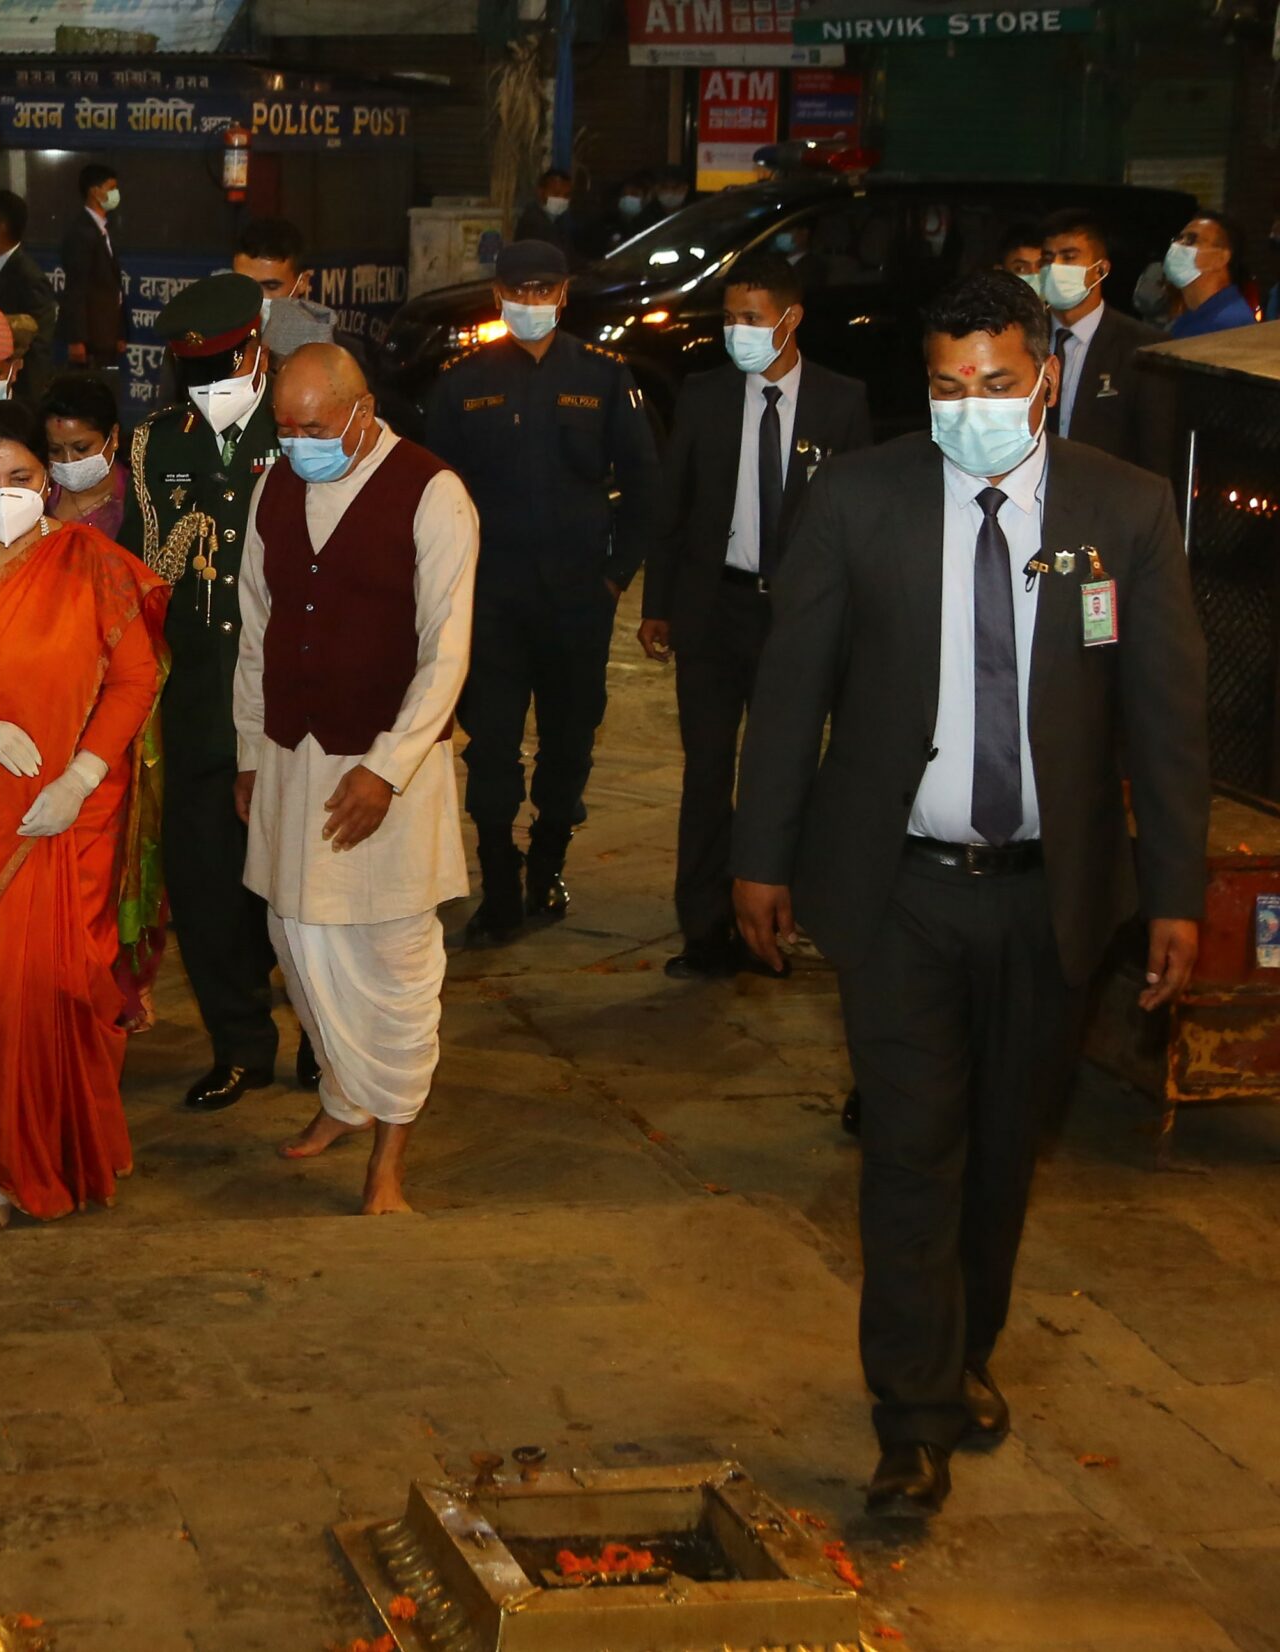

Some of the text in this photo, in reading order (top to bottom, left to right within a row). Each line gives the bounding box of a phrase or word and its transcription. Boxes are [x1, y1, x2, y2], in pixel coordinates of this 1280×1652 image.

[644, 0, 723, 33] ATM
[822, 10, 1062, 40] NIRVIK STORE
[703, 71, 773, 101] ATM
[13, 101, 64, 129] असन
[74, 97, 118, 130] सेवा
[251, 102, 410, 136] POLICE POST
[322, 267, 346, 304] MY
